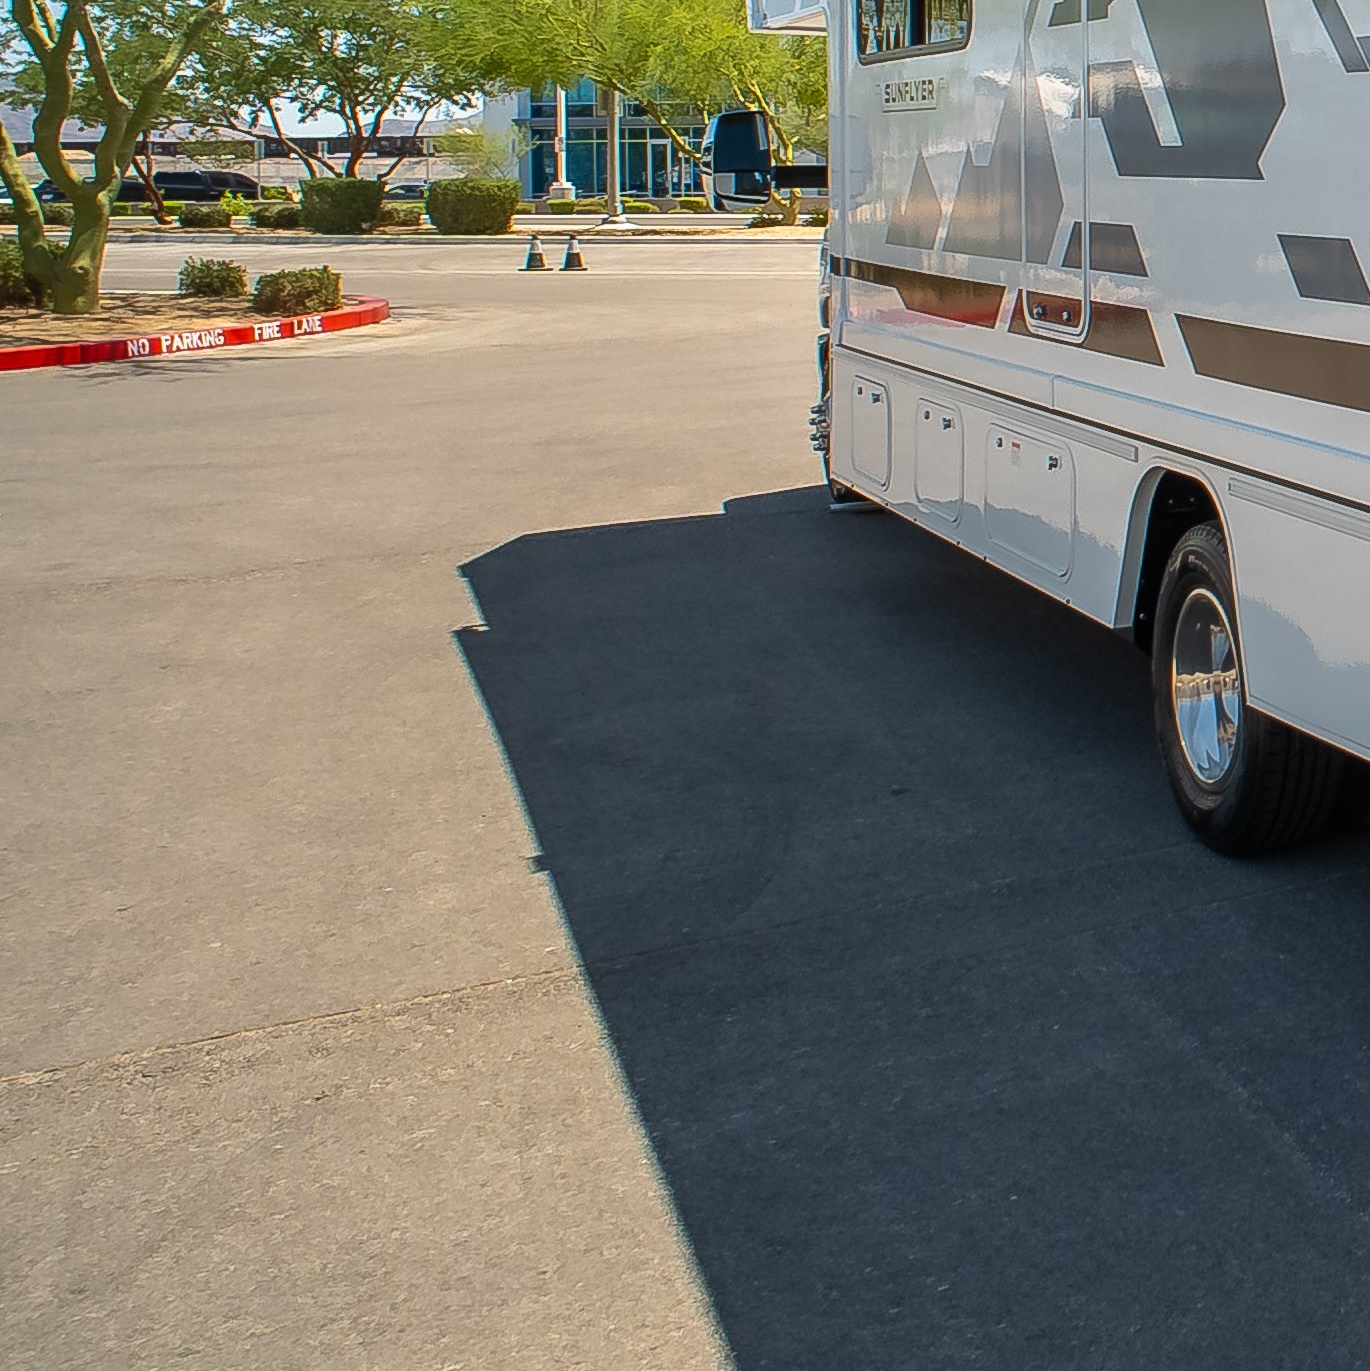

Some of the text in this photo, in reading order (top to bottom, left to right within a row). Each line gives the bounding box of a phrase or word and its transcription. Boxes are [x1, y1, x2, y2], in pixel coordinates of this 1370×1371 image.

[884, 78, 935, 104] SUNFLYER
[126, 315, 323, 357] NO PARKING FIRE LANE
